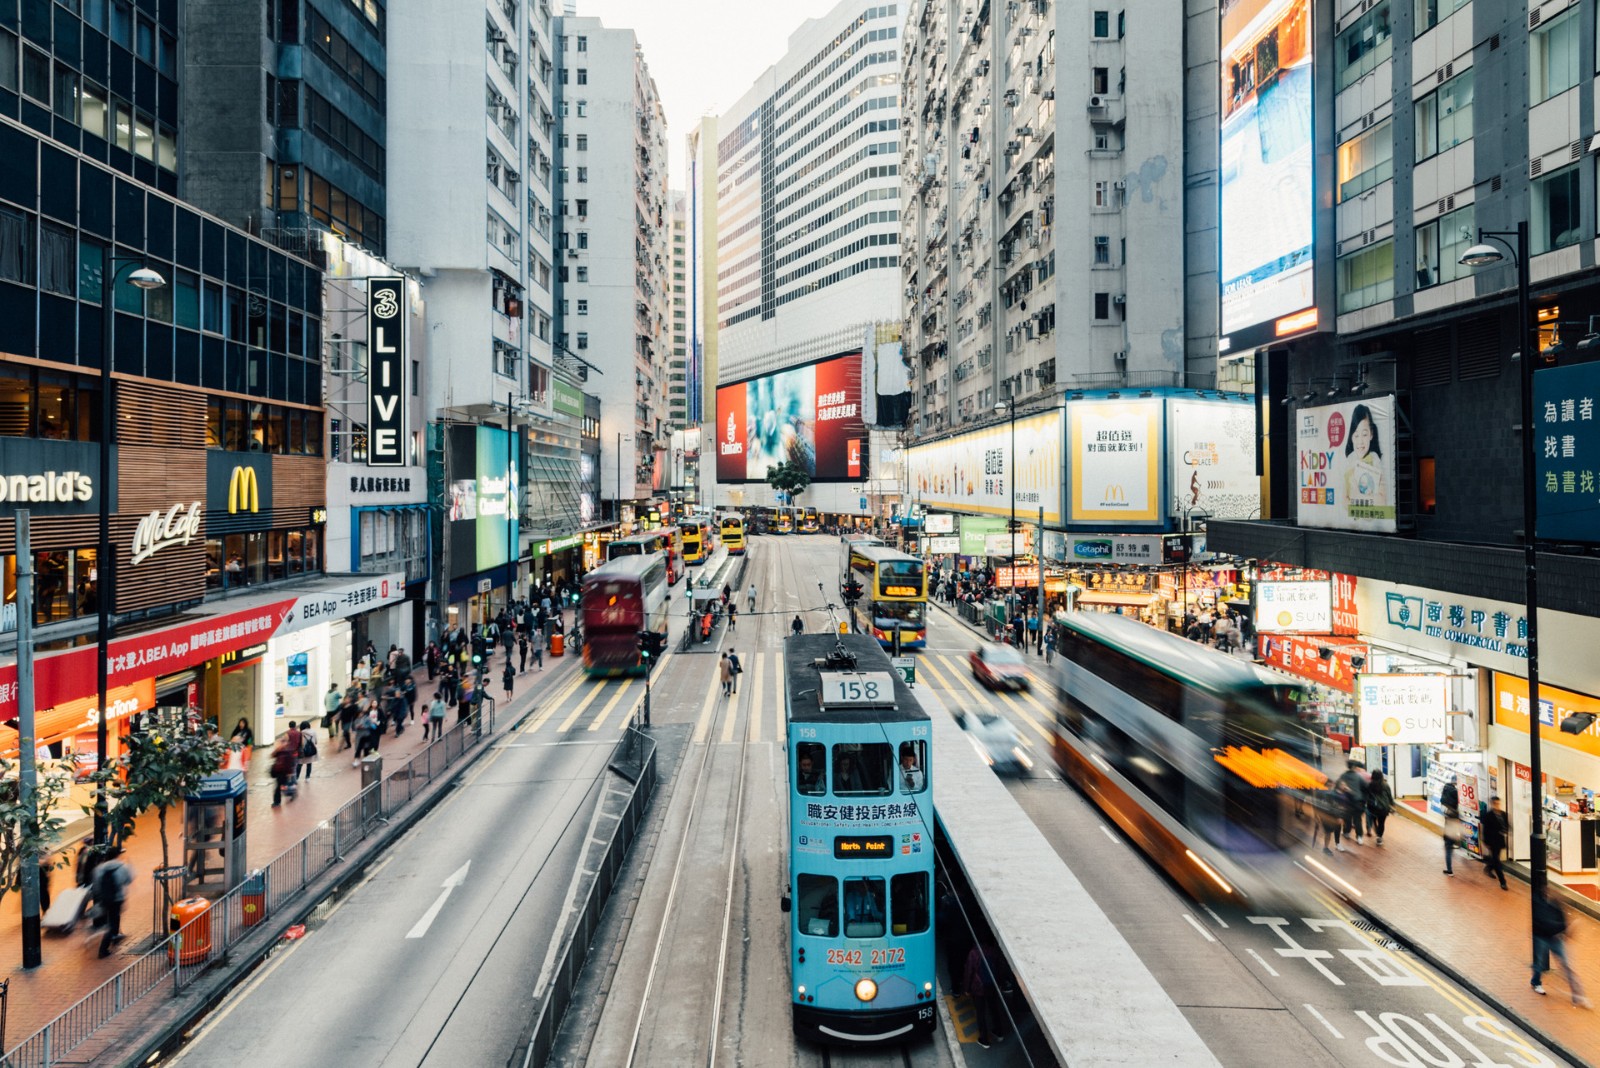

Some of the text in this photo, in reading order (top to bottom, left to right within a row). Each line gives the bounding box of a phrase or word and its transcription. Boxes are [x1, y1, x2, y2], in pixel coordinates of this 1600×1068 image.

[374, 326, 399, 456] LIVE
[1544, 397, 1594, 423] 為讀者
[1096, 430, 1133, 441] 超值選
[1544, 434, 1576, 458] 找書
[1301, 471, 1327, 487] LAND
[1076, 543, 1111, 557] Cetaphil
[303, 600, 337, 619] BEA App
[1295, 611, 1326, 622] SUN
[1425, 625, 1442, 638] THE
[1444, 629, 1502, 652] COMMERCIAL
[170, 642, 188, 657] App
[839, 681, 880, 701] 158
[911, 725, 928, 736] 158
[1405, 717, 1442, 730] SUN
[799, 727, 817, 738] 158
[1461, 784, 1475, 800] 98
[807, 802, 918, 821] 職安健投訴熱線
[841, 842, 861, 850] North
[865, 842, 885, 850] Point
[827, 948, 906, 965] 2542 2172
[918, 1007, 933, 1020] 158
